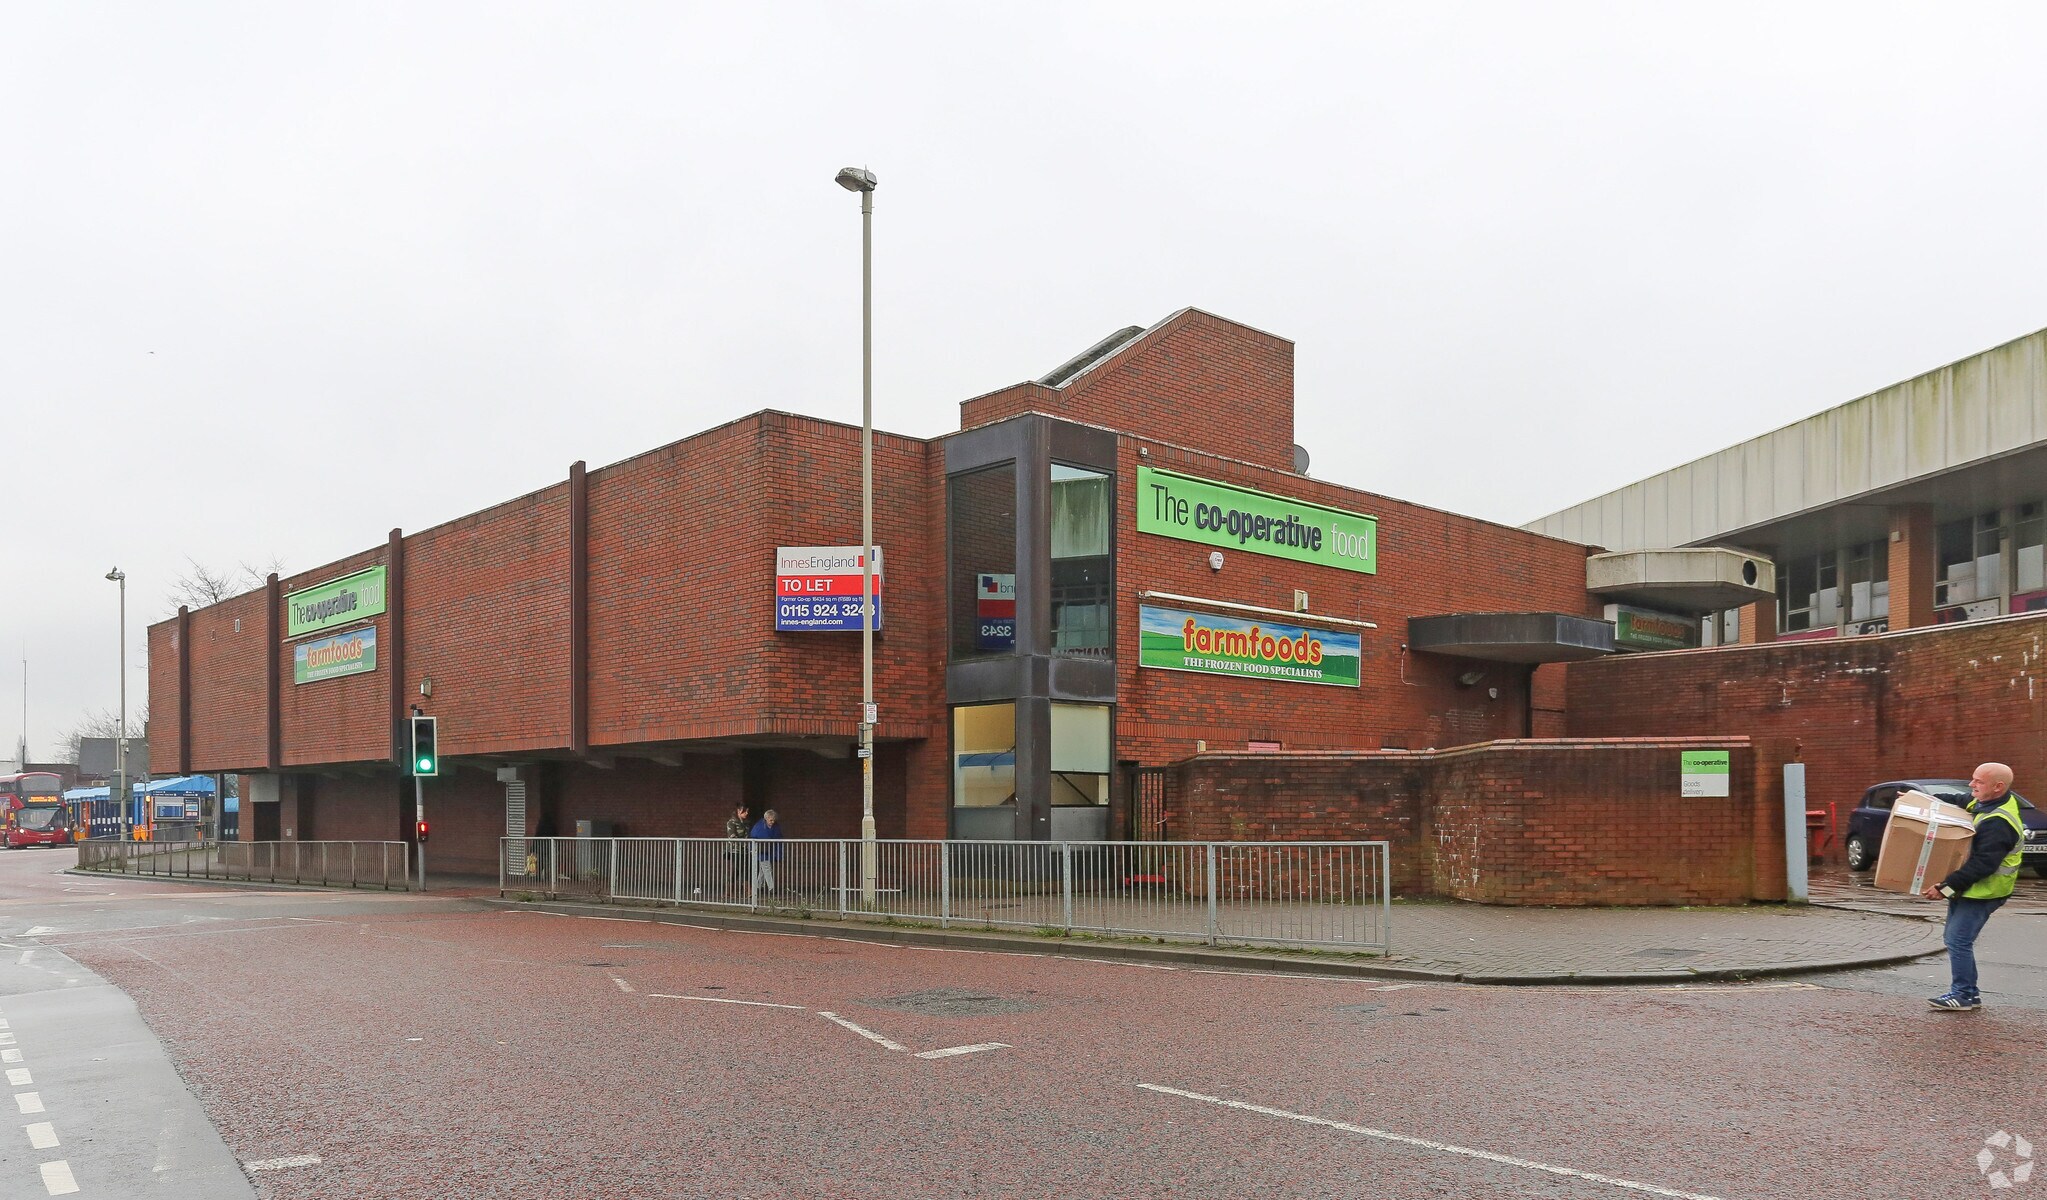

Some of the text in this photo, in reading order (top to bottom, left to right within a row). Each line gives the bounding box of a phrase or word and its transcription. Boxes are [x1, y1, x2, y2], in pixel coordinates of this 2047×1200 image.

[1151, 483, 1368, 561] The co-operative food
[781, 555, 855, 571] InnesEngland
[782, 579, 833, 592] TO LET
[292, 578, 380, 626] The co-operative food
[781, 604, 810, 617] 0115
[813, 604, 838, 617] 924
[781, 618, 843, 626] innes-england.com
[306, 634, 363, 669] farmfoods
[1183, 617, 1323, 666] farmfoods
[1184, 656, 1323, 679] THE FROZEN FOOD SPECIALISTS
